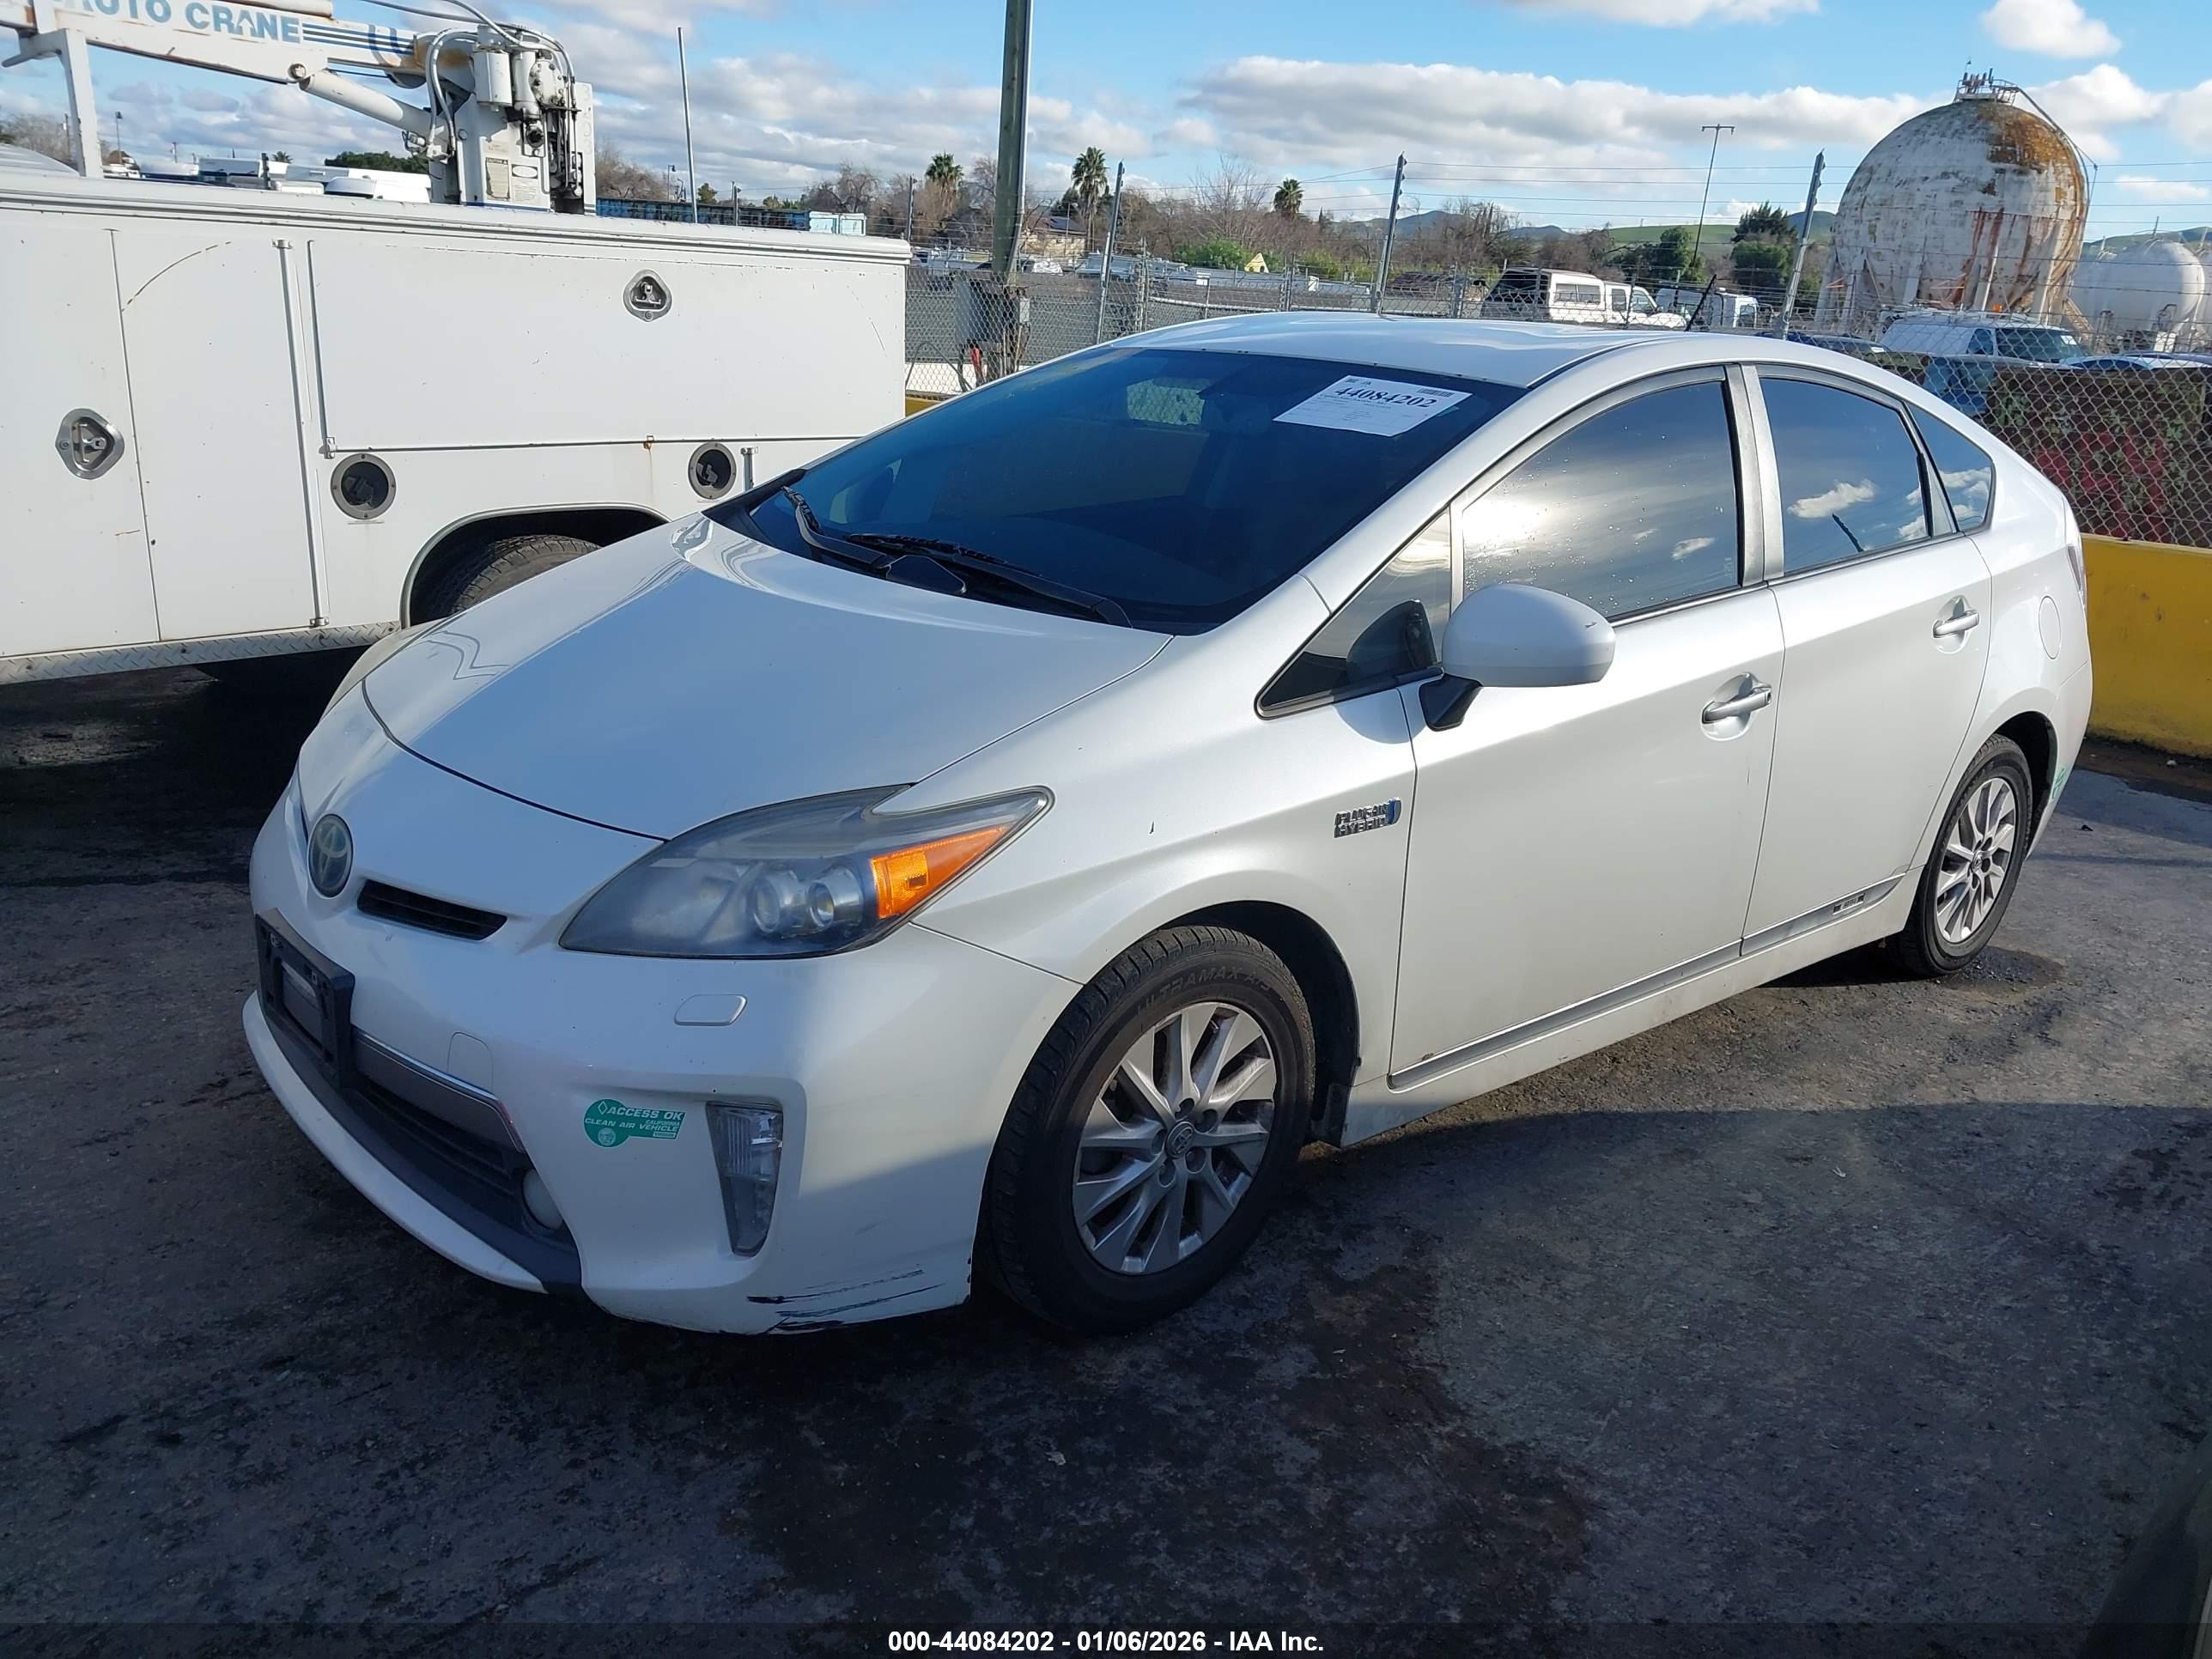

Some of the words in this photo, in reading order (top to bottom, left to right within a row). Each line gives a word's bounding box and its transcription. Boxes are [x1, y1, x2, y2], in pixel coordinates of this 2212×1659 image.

[184, 2, 301, 44] CRANE
[1334, 386, 1437, 408] 44084202
[606, 1106, 660, 1119] ACCESS
[663, 1111, 684, 1121] OK
[584, 1117, 617, 1127] CLEAN
[639, 1122, 679, 1133] VEHICLE
